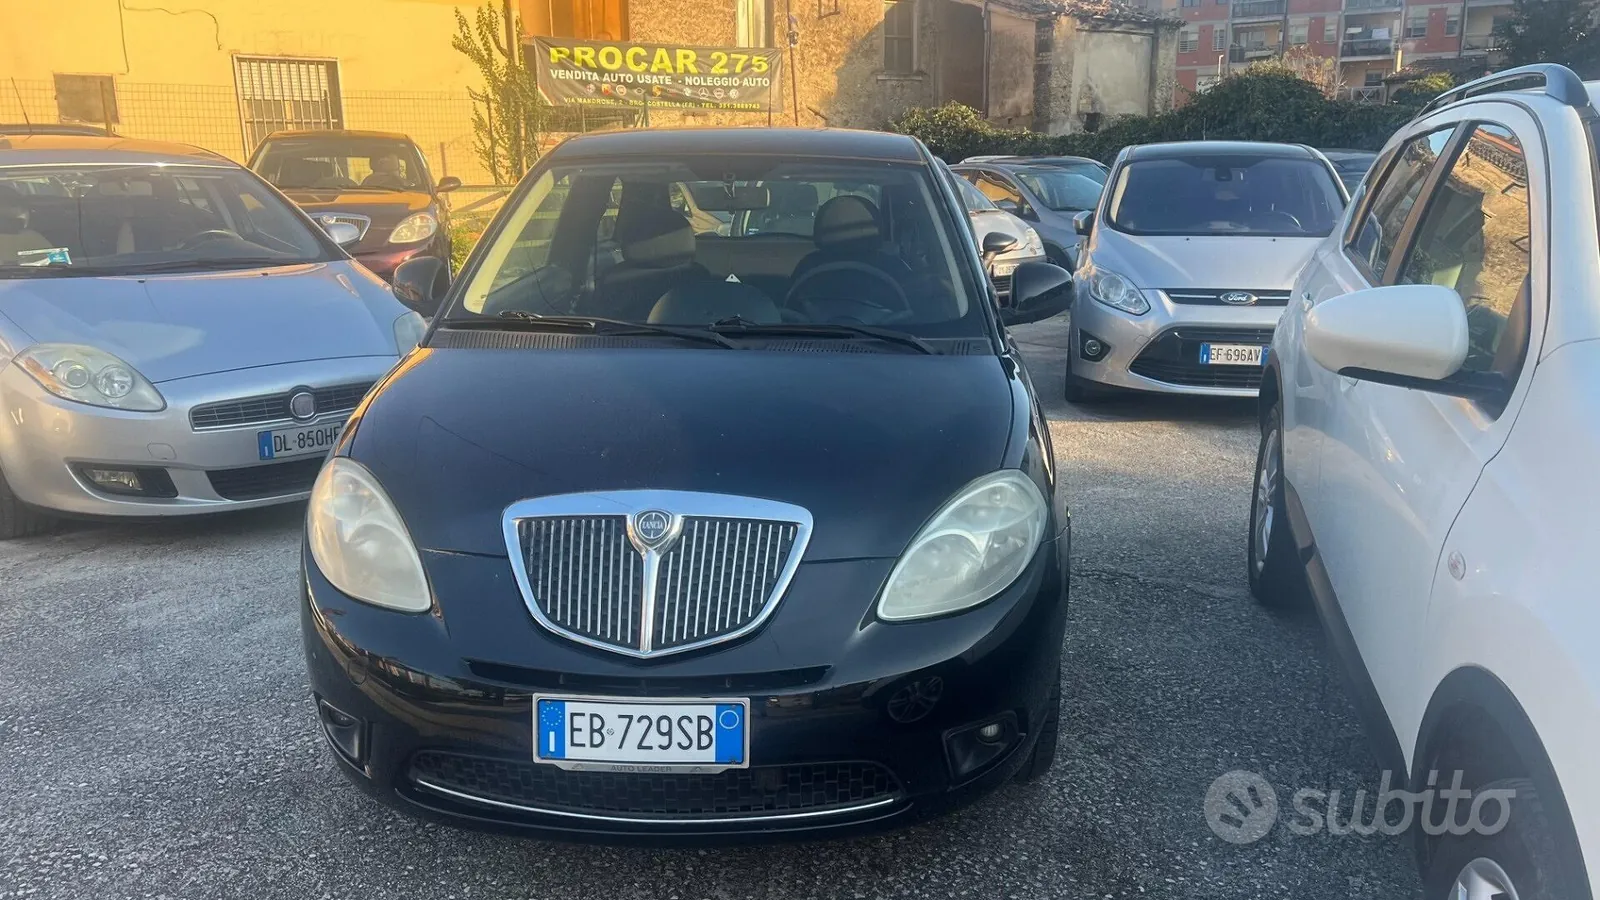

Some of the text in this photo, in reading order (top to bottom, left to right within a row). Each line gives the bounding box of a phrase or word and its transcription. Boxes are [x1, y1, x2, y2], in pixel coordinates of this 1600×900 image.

[550, 46, 769, 74] PROCAR 275
[550, 69, 600, 81] VENDITA
[603, 72, 634, 83] AUTO
[637, 75, 672, 84] USATE
[685, 76, 740, 86] NOLEGGIO
[742, 77, 770, 87] AUTO
[1227, 293, 1248, 301] Ford
[642, 521, 664, 530] LANCIA
[637, 765, 672, 773] LEADER
